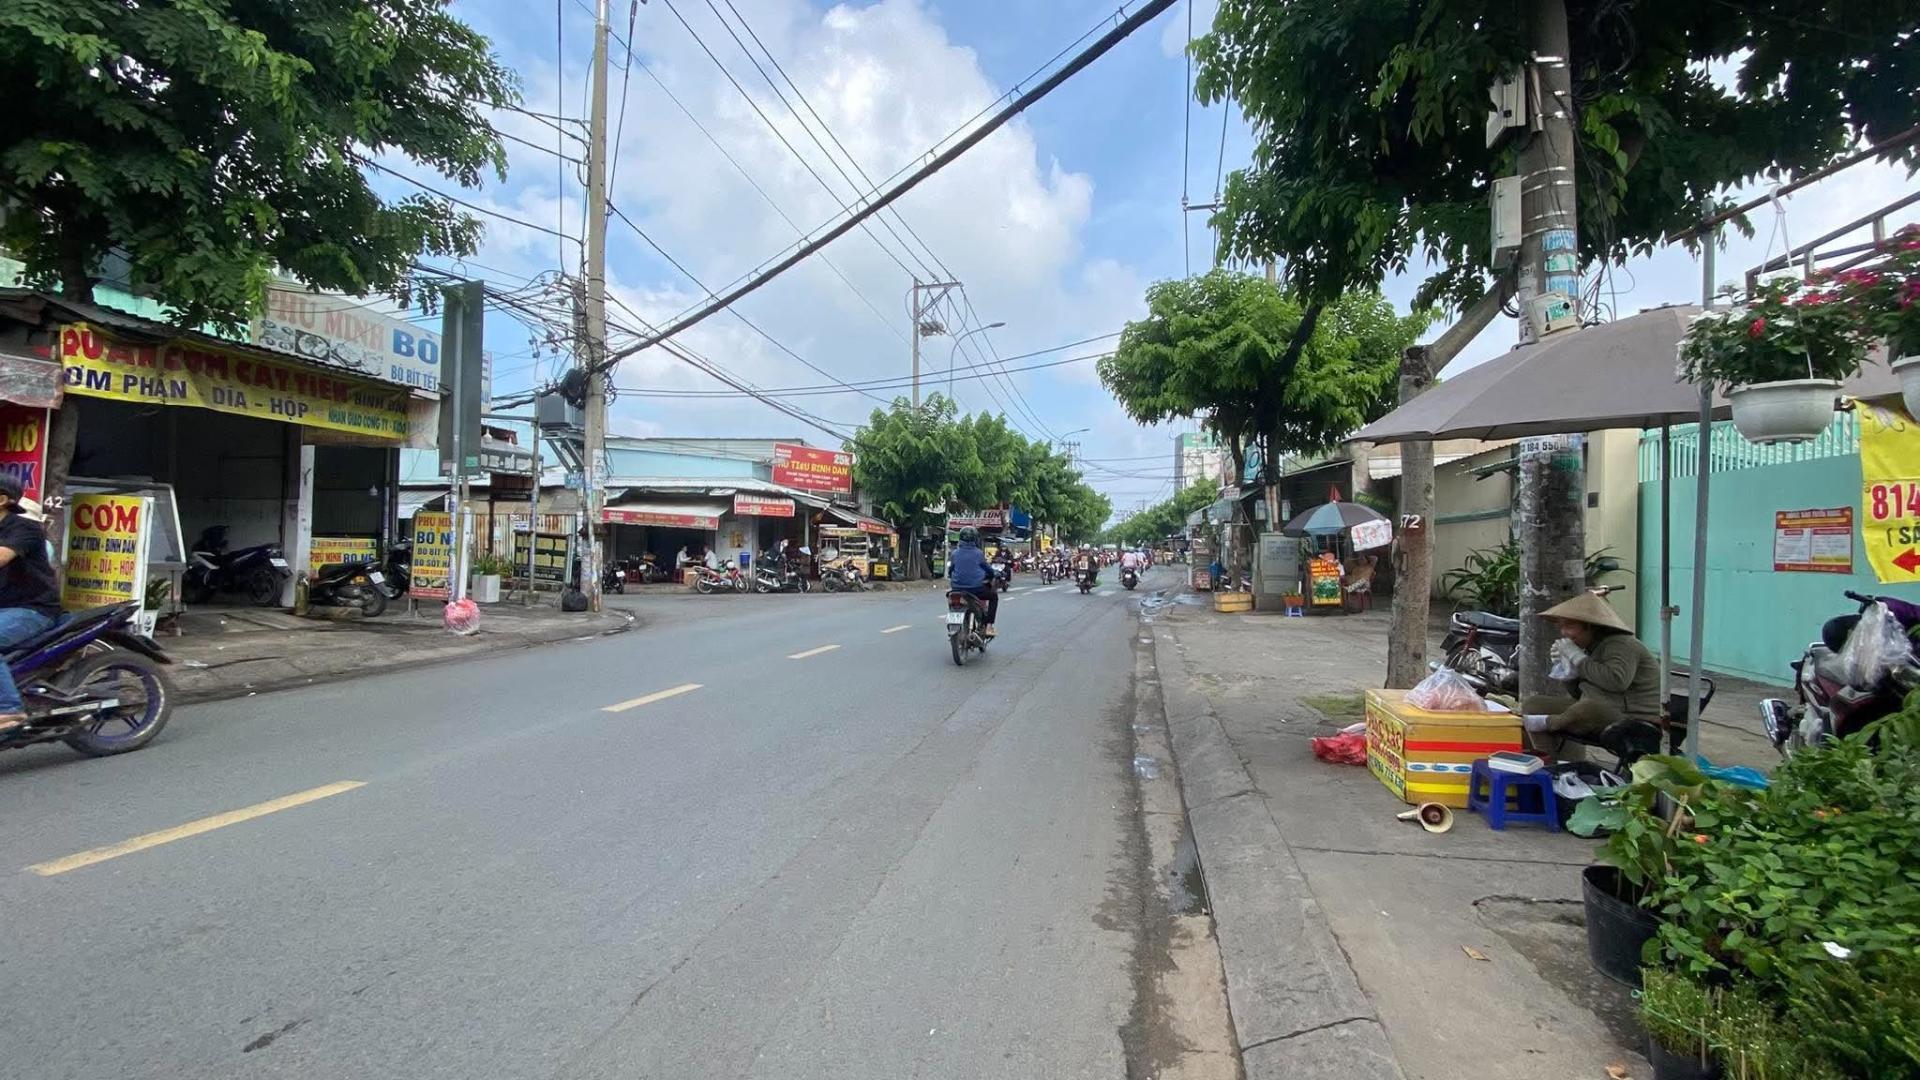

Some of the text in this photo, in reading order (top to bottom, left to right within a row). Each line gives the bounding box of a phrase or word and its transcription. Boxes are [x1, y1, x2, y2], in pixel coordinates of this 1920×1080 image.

[393, 328, 438, 365] BÒ
[44, 496, 64, 509] 42
[74, 500, 139, 533] CƠM
